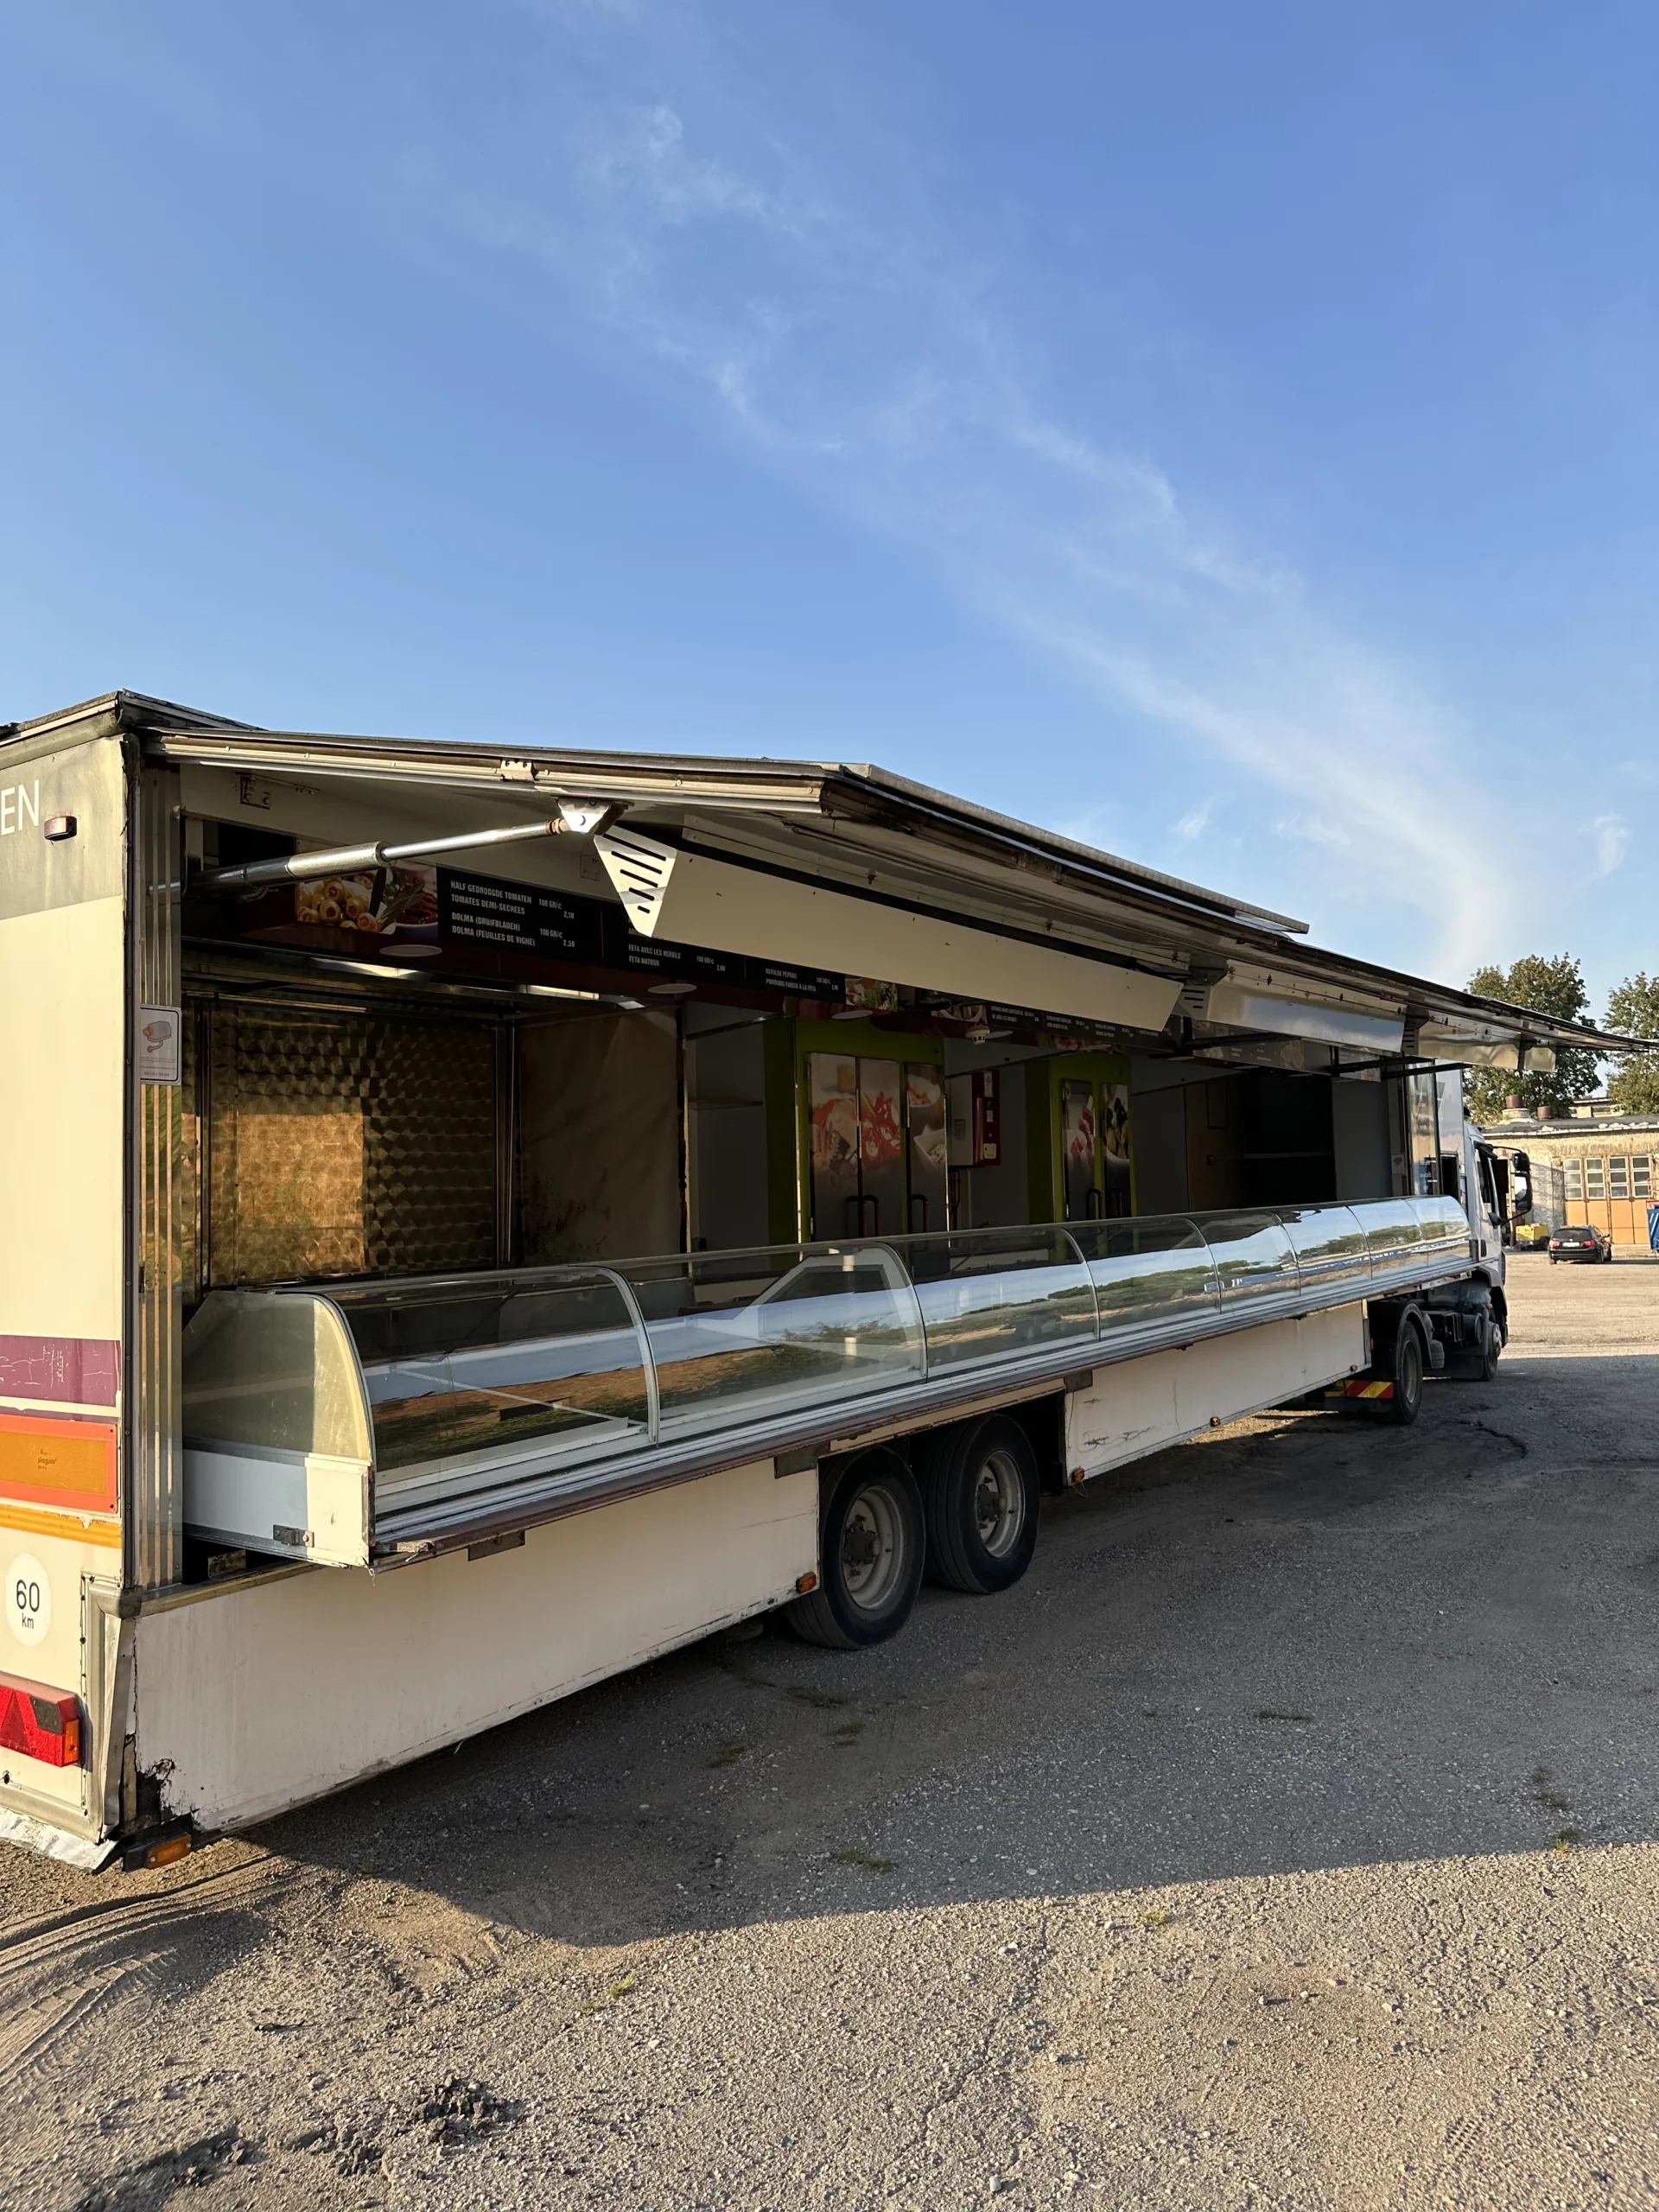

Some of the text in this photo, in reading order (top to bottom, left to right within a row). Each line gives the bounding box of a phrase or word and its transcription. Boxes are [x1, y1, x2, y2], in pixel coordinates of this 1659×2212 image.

[450, 880, 467, 891] HALF
[467, 884, 504, 899] GEDROOGDE
[505, 891, 532, 904] TOMATEN
[538, 899, 549, 907] 100
[451, 893, 480, 906] TOMATES
[481, 899, 525, 915] DEMI-SECHEES
[452, 912, 474, 924] DOLMA
[475, 916, 521, 931] (DRUIFBLADEN)
[539, 928, 549, 937] 100
[452, 925, 474, 937] DOLMA
[476, 929, 505, 942] (FEUILLES
[506, 934, 515, 943] DE
[516, 936, 536, 947] VIGNE)
[628, 944, 640, 952] FETA
[640, 945, 653, 954] AVEC
[628, 955, 640, 963] FETA
[16, 1580, 40, 1612] 60
[22, 1612, 35, 1630] km
